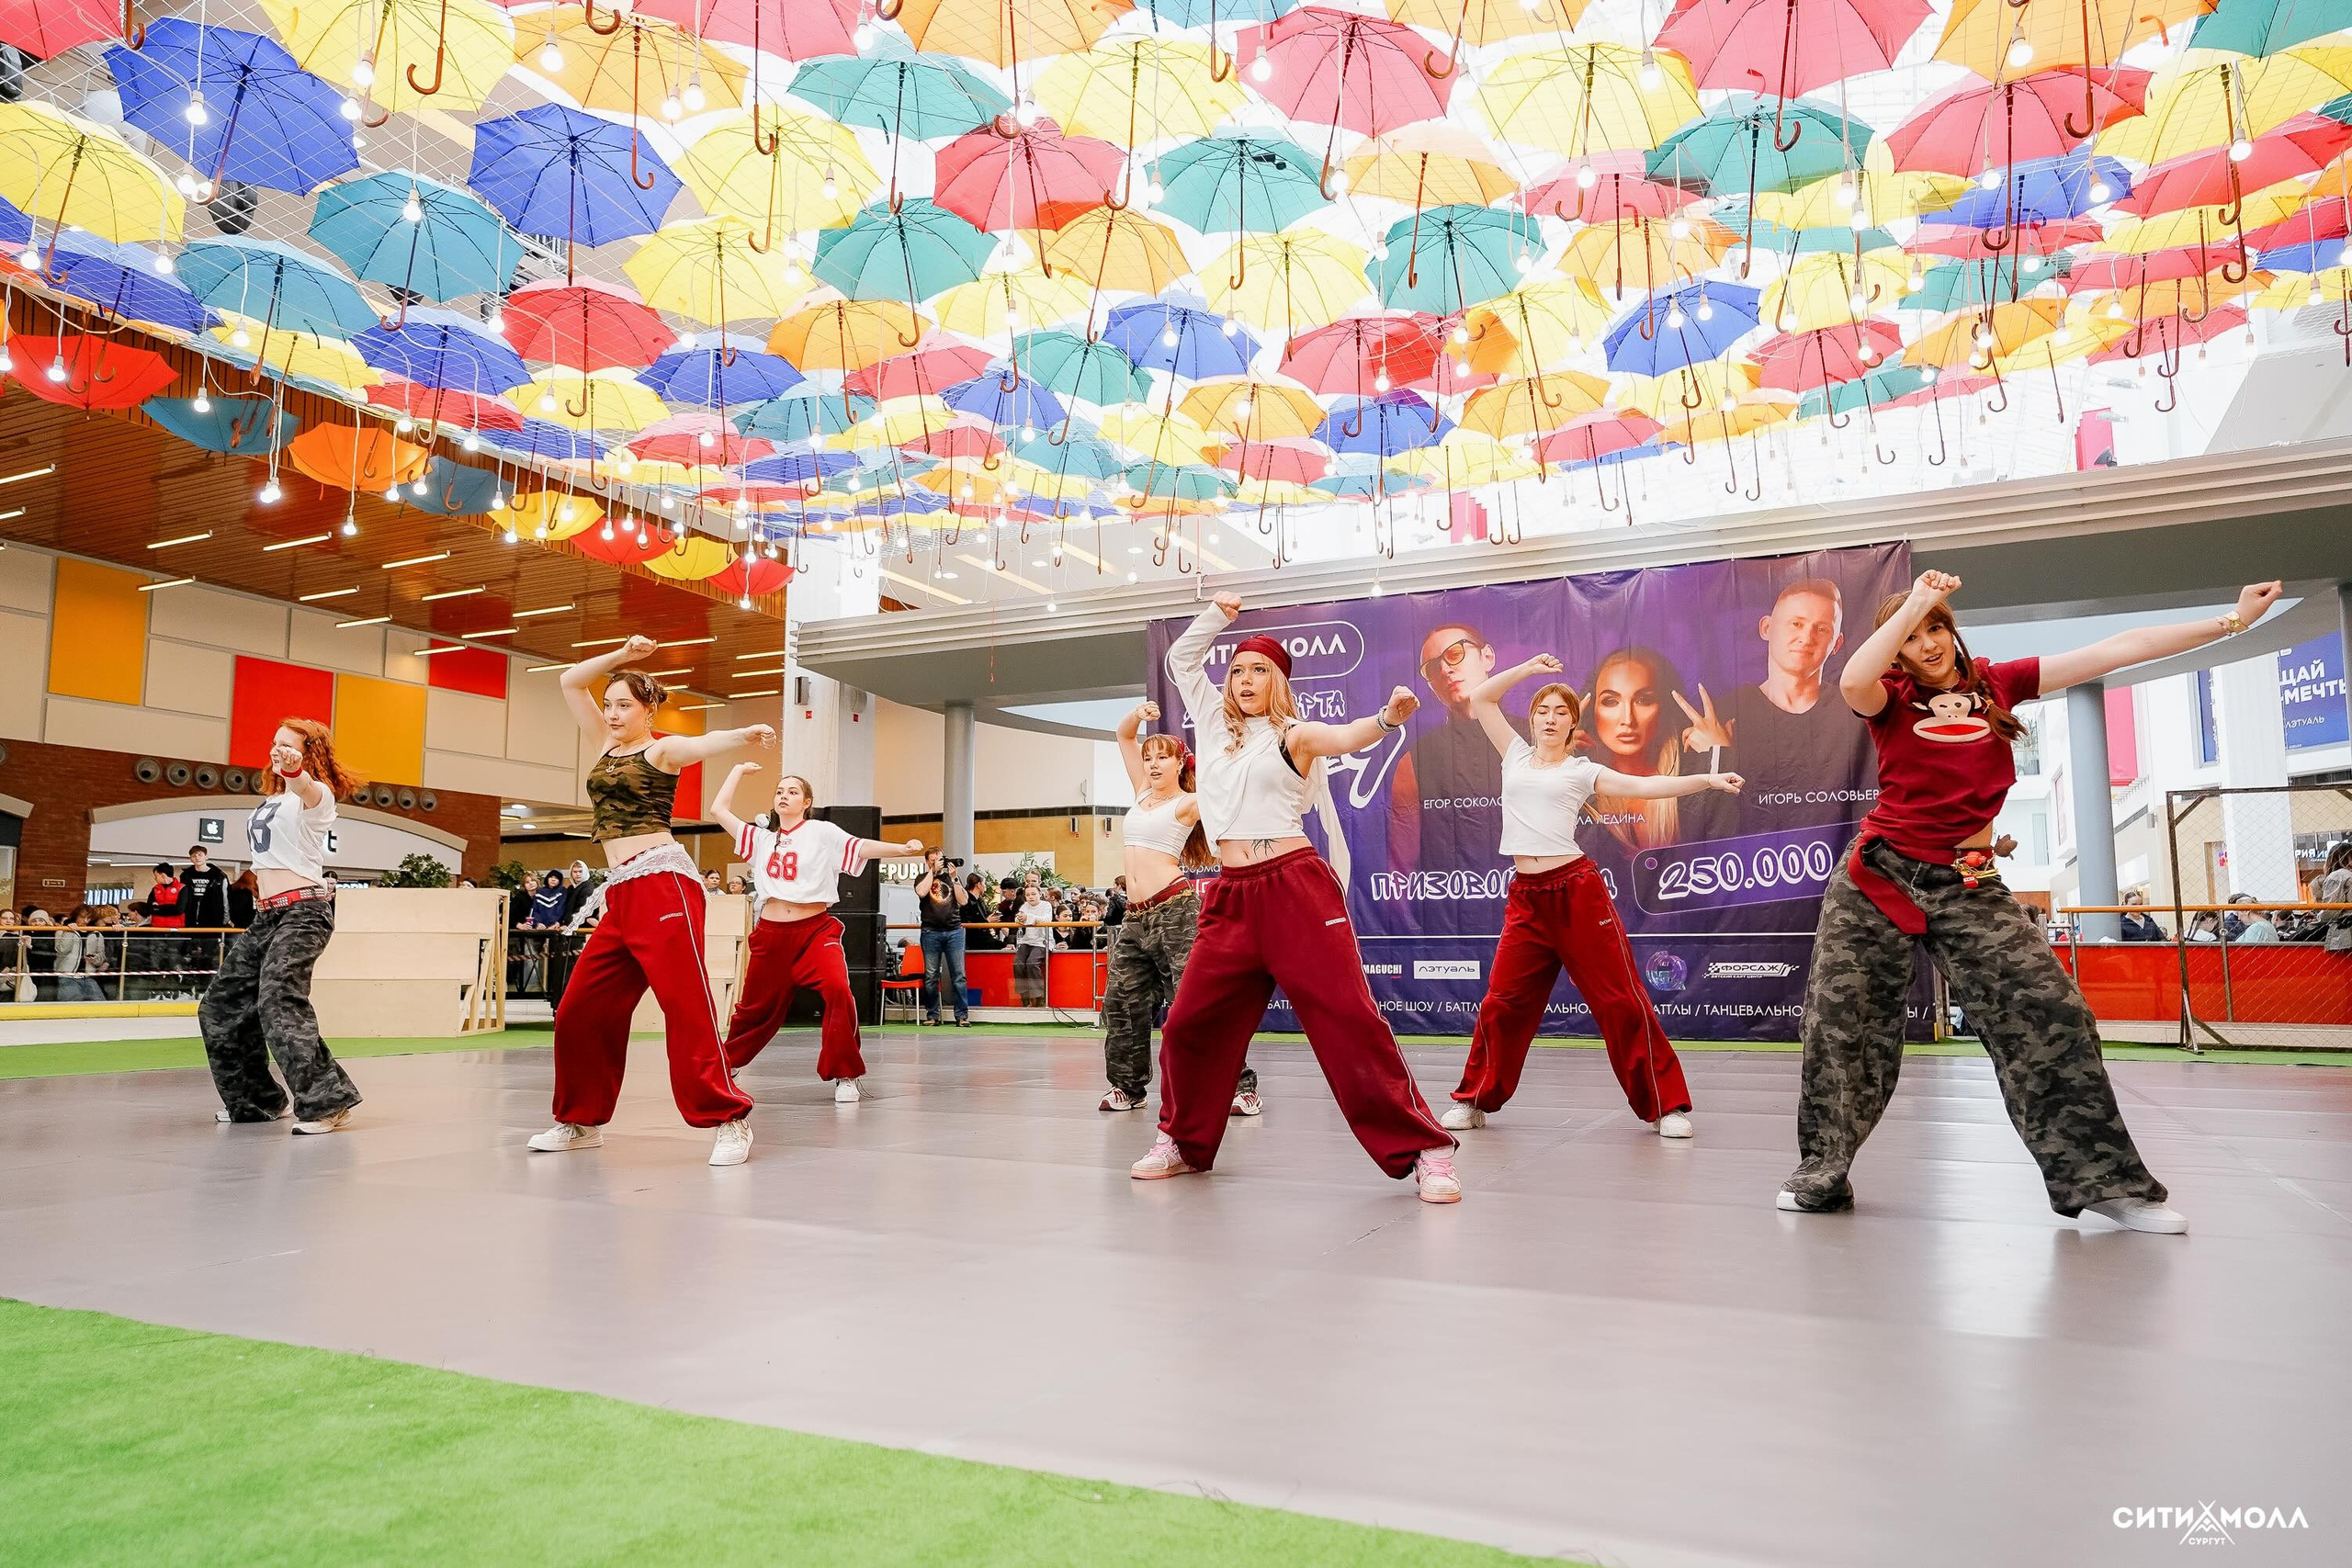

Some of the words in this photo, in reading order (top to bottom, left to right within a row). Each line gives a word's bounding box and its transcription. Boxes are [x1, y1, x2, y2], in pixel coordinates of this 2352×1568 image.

[1293, 690, 1346, 721] РТА
[1423, 798, 1451, 809] ЕГОР
[1453, 796, 1503, 808] СОКОЛО
[1758, 793, 1802, 805] ИГОРЬ
[765, 851, 798, 882] 68
[1657, 840, 1834, 900] 250.000
[1363, 964, 1402, 975] MAGUCHI
[1405, 1001, 1434, 1012] ШОУ
[1654, 1004, 1691, 1015] АТТЛЫ
[1703, 1005, 1804, 1017] ТАНЦЕВАЛЬНО
